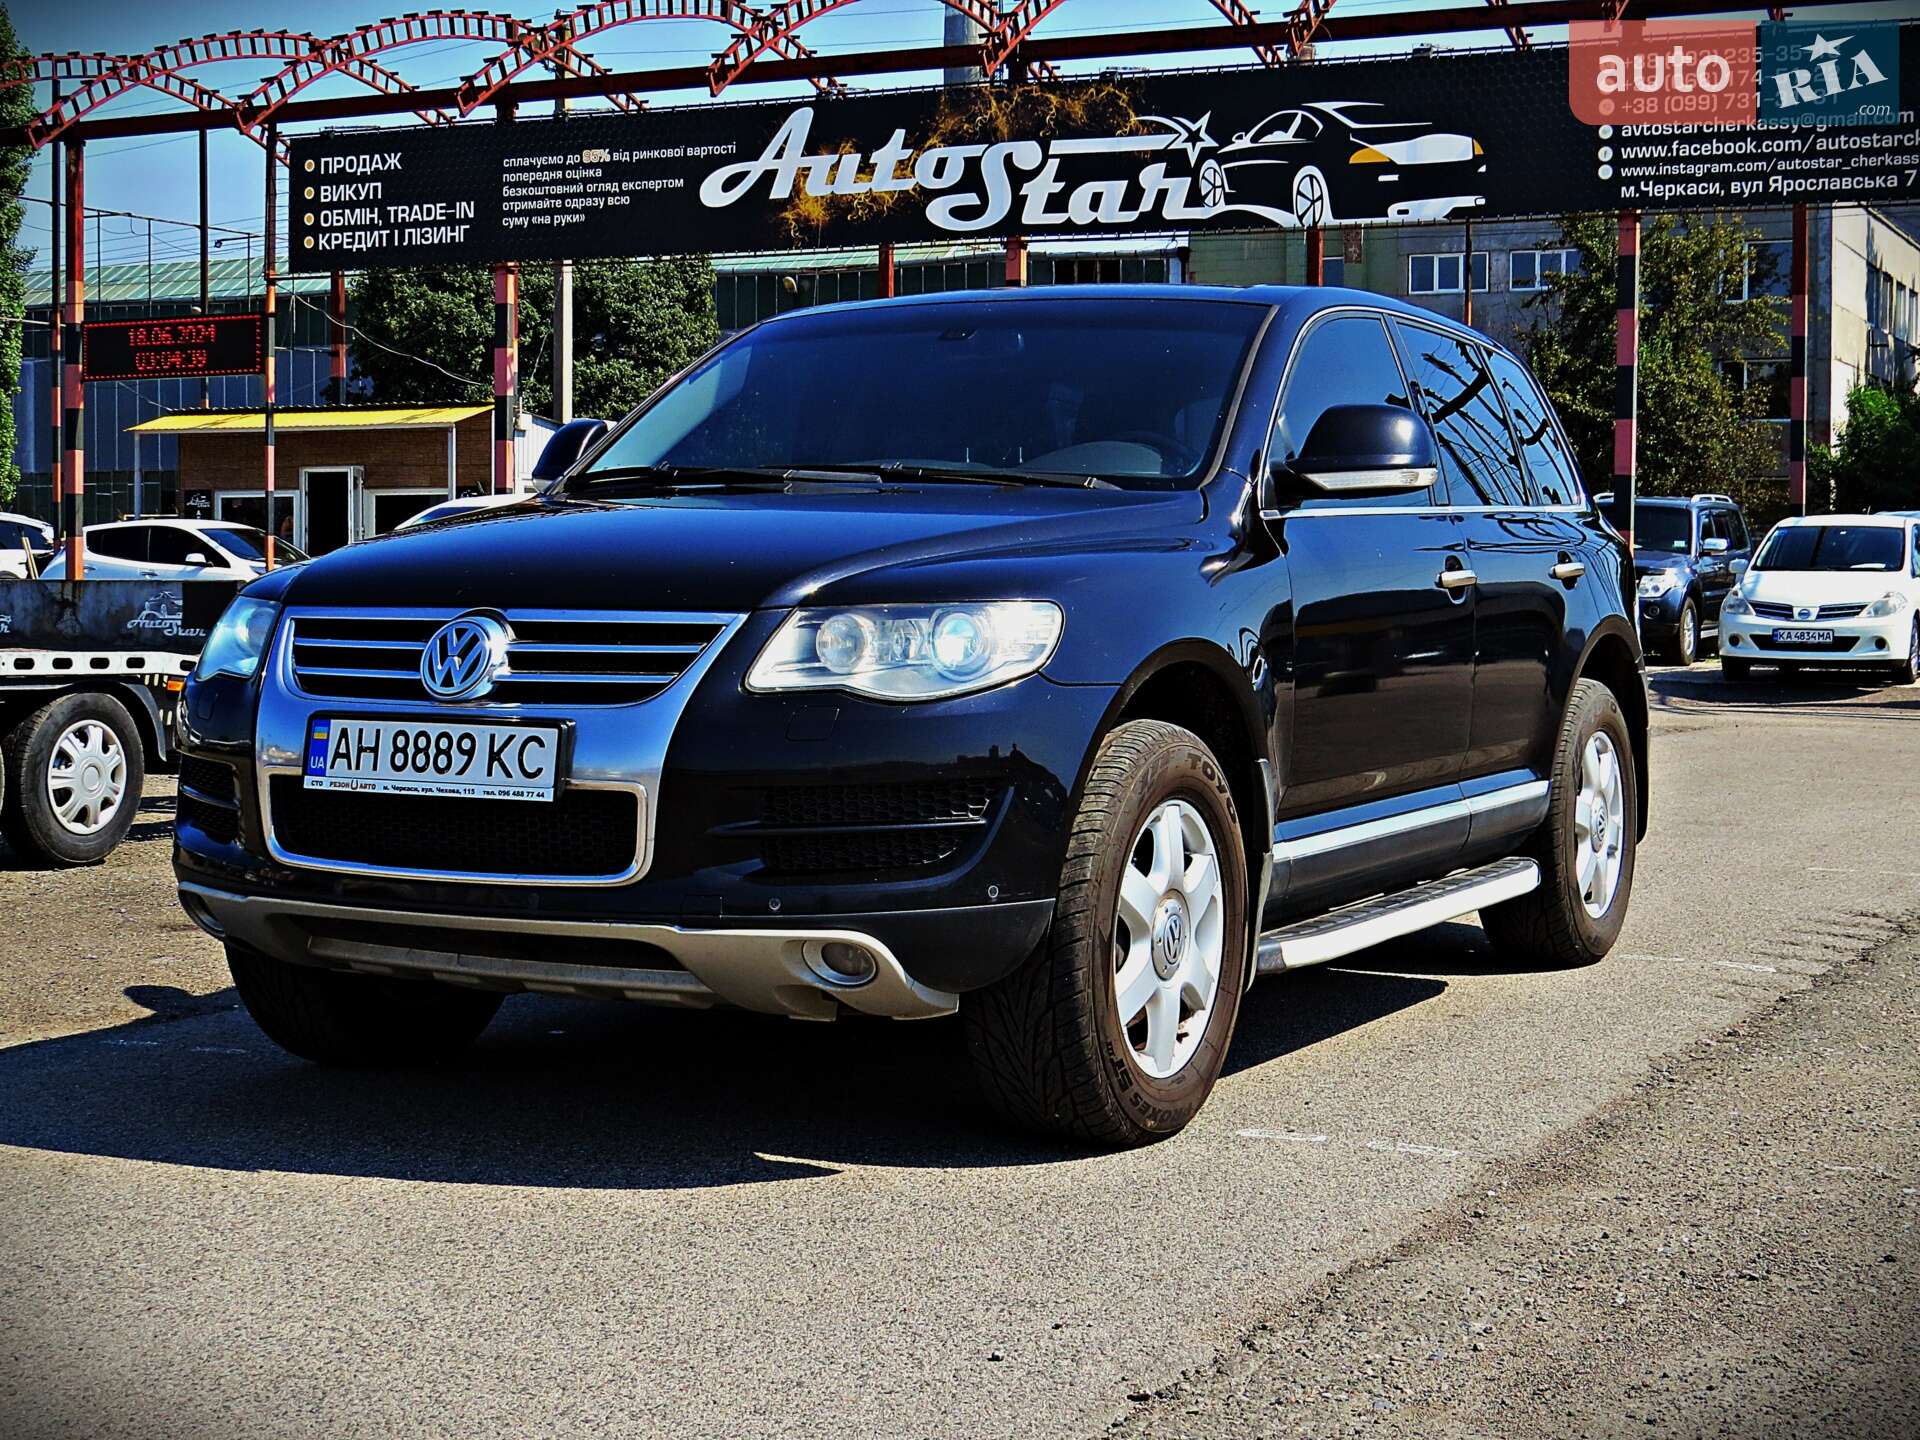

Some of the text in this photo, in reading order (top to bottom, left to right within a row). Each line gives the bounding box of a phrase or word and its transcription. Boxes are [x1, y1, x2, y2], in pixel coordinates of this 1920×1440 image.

[320, 152, 402, 176] ПРОДАЖ
[503, 155, 564, 169] сплачуємо
[566, 154, 580, 165] до
[613, 151, 630, 163] від
[632, 145, 685, 163] ринкової
[687, 141, 737, 159] вартості
[503, 166, 602, 184] попередня оцінка
[1621, 169, 1917, 200] м.Черкаси, вул Ярославська 7
[320, 182, 382, 202] ВИКУП
[503, 178, 684, 197] безкоштовний огляд експертом
[320, 201, 474, 227] ОБМІН, TRADE-IN
[503, 195, 630, 213] отримайте одразу всю
[502, 213, 586, 229] суму «на руки»
[319, 229, 390, 252] КРЕДИТ
[403, 225, 470, 246] ЛІЗИНГ
[1778, 631, 1832, 641] KA 4834 MA
[310, 755, 325, 769] UA
[330, 727, 546, 779] AH 8889 KC
